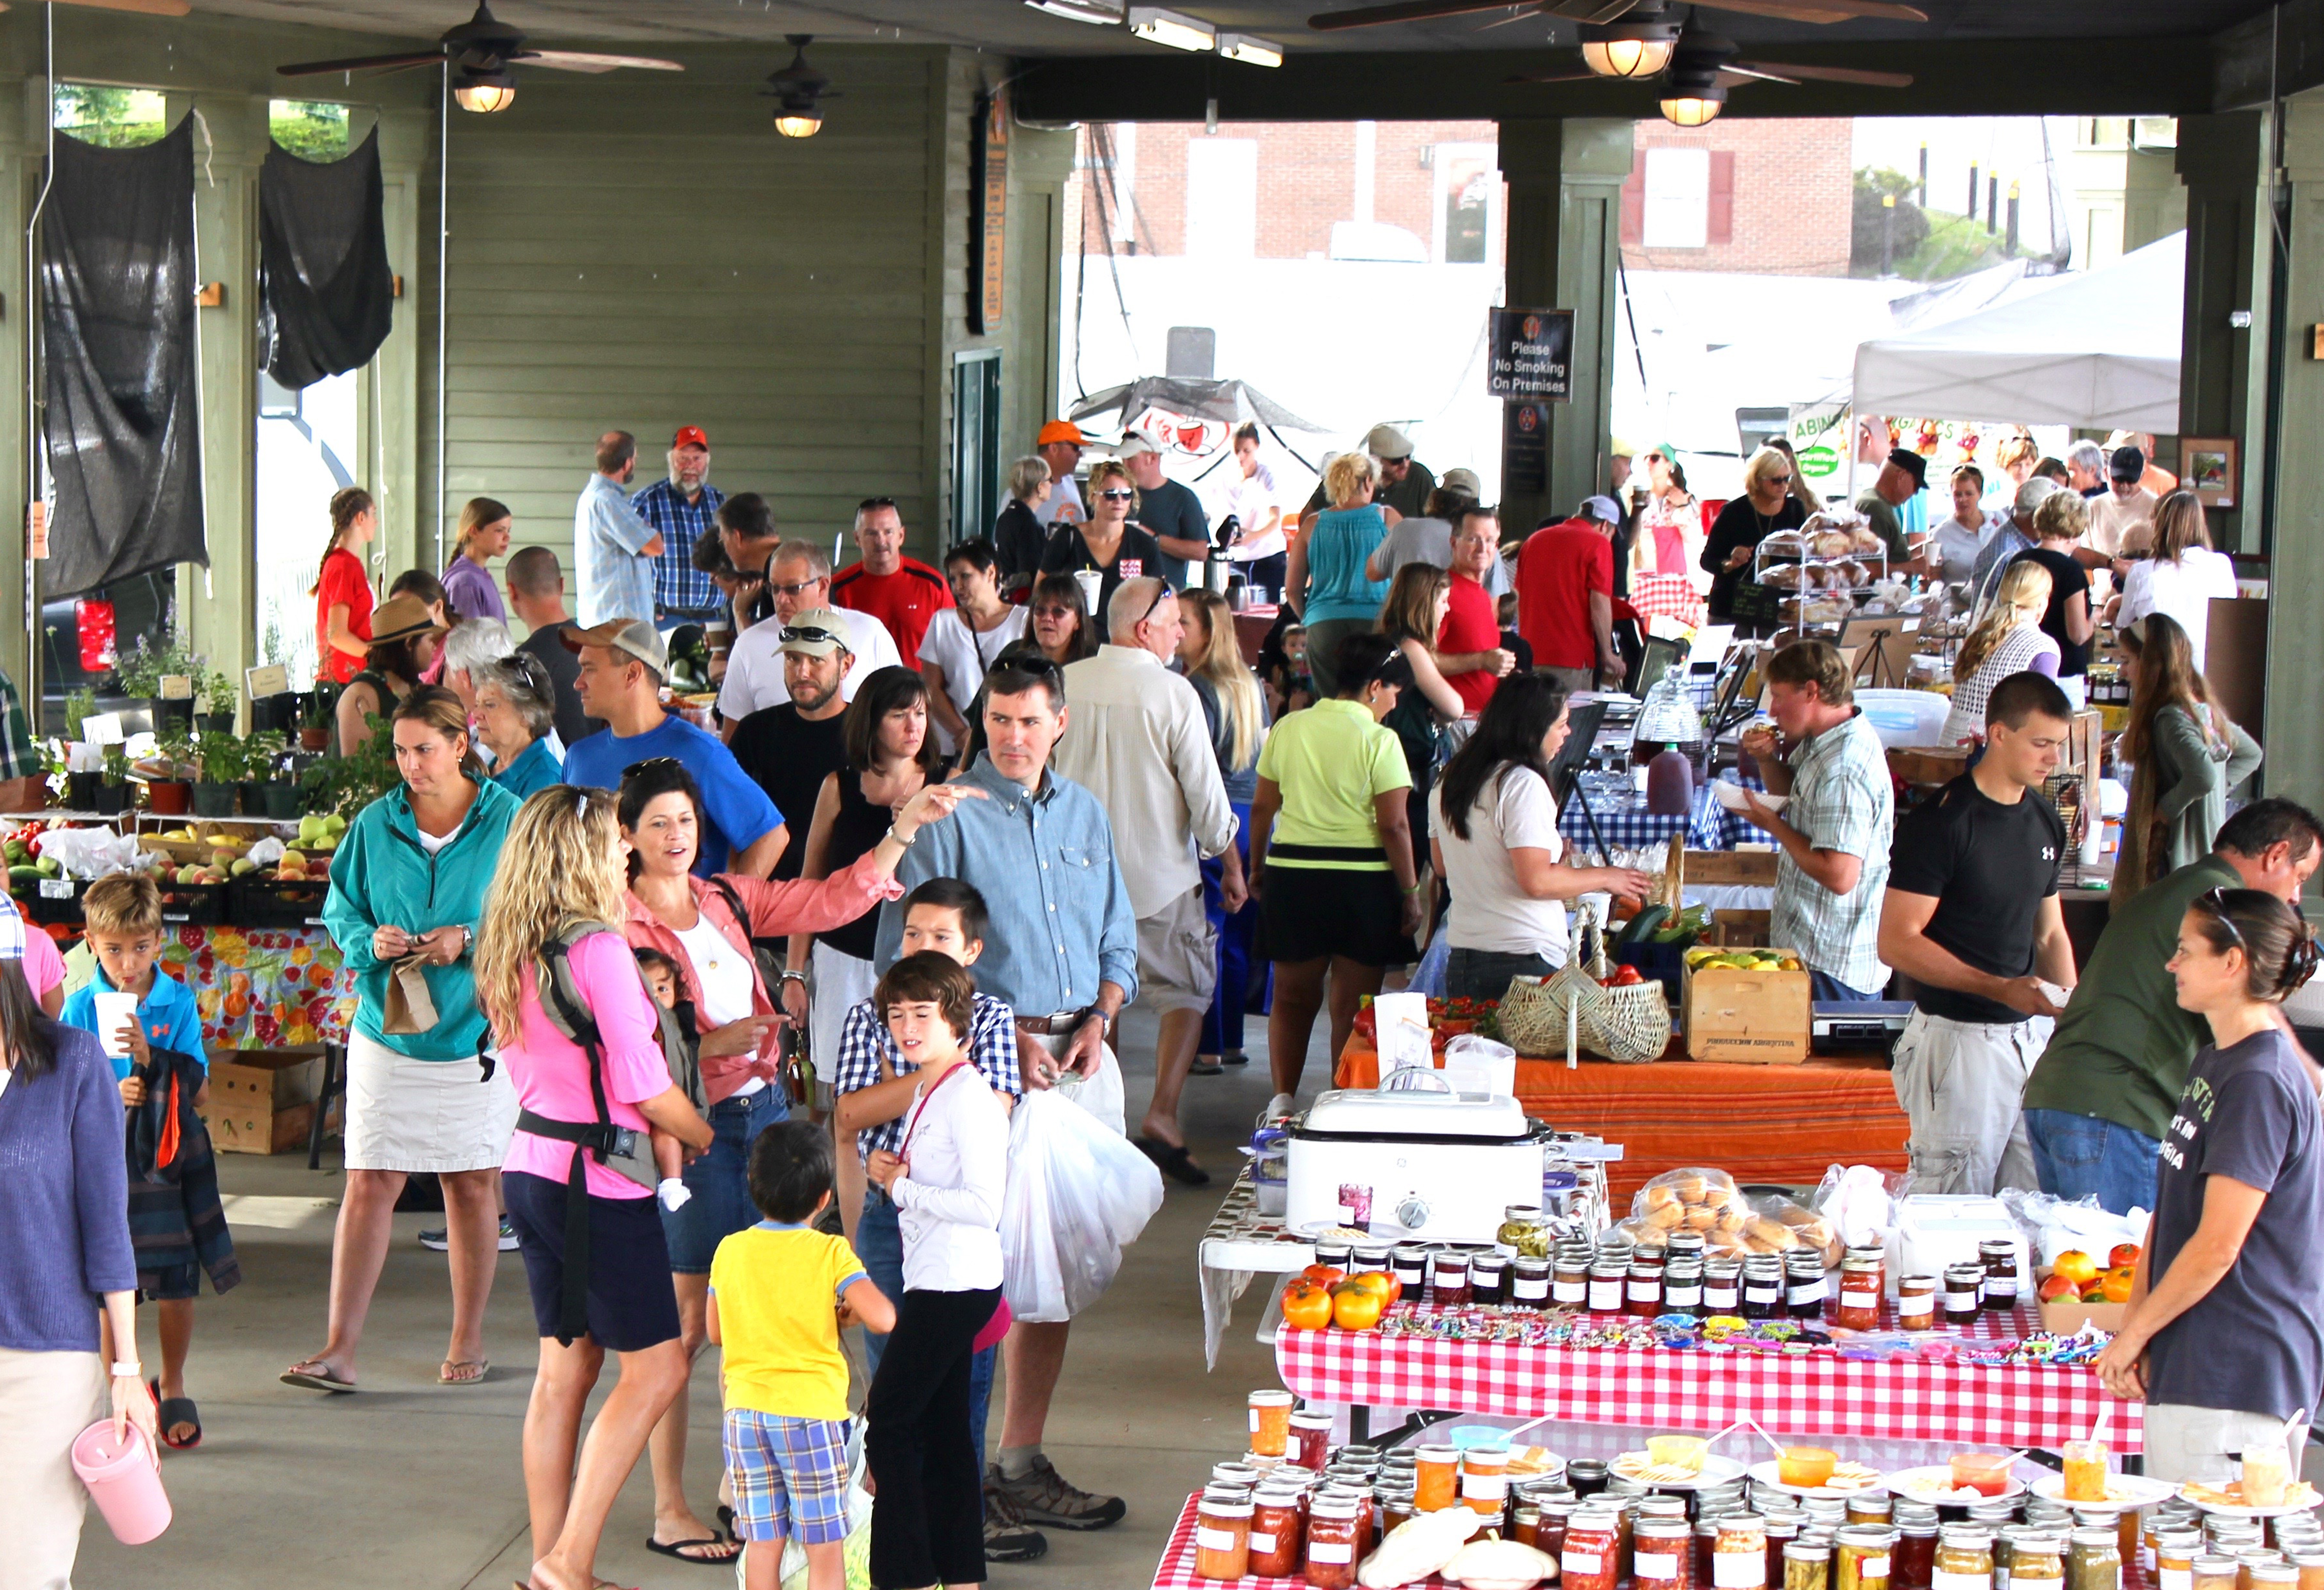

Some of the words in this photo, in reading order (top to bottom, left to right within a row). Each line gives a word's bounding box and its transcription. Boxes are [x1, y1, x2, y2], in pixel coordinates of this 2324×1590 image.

[1511, 341, 1550, 355] Please
[1495, 358, 1511, 372] No
[1514, 360, 1565, 378] Smoking
[1493, 376, 1509, 389] On
[1513, 377, 1566, 393] Premises
[1798, 452, 1838, 463] Certified
